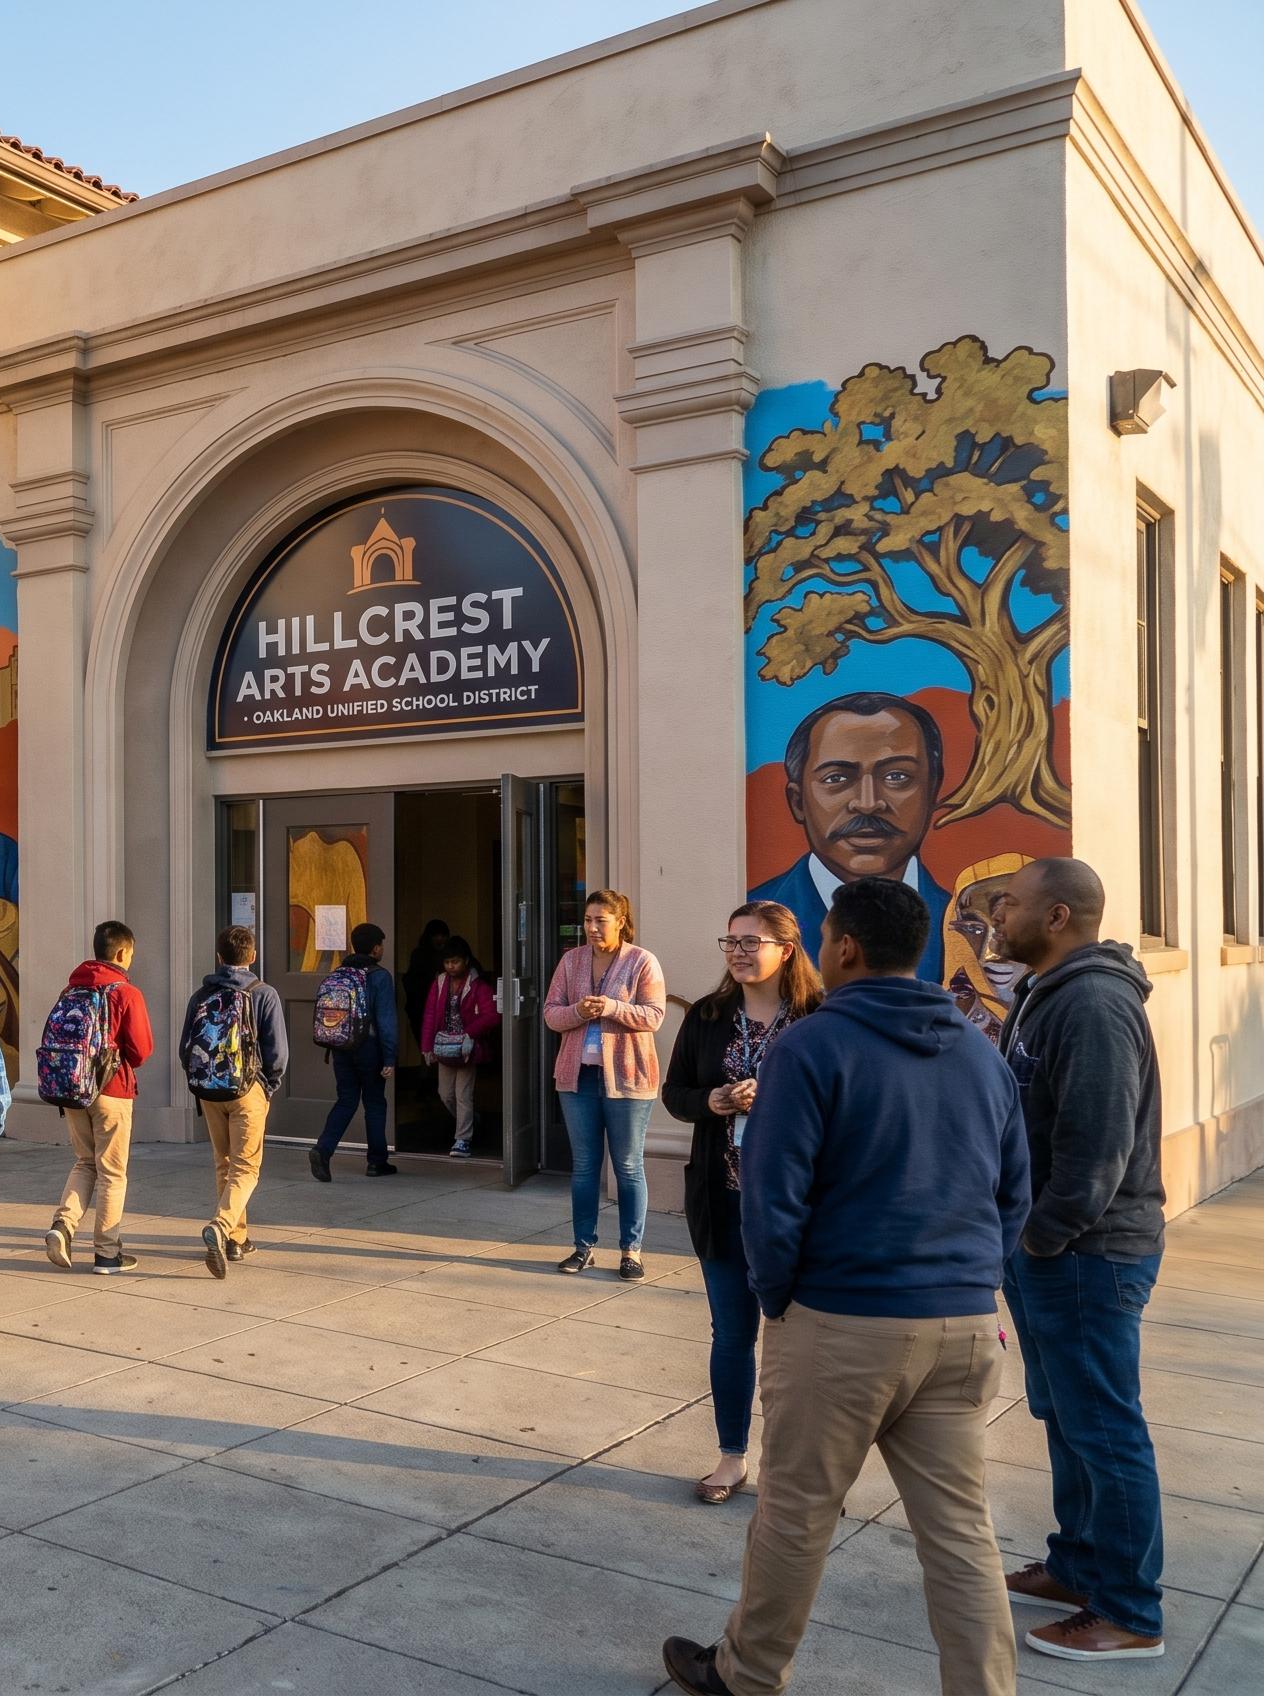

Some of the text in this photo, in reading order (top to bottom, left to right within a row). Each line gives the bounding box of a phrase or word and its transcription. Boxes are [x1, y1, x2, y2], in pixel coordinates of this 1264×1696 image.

[258, 587, 524, 658] HILLCREST
[236, 637, 551, 702] ARTS ACADEMY
[253, 685, 539, 724] OAKLAND UNIFIED SCHOOL DISTRICT
